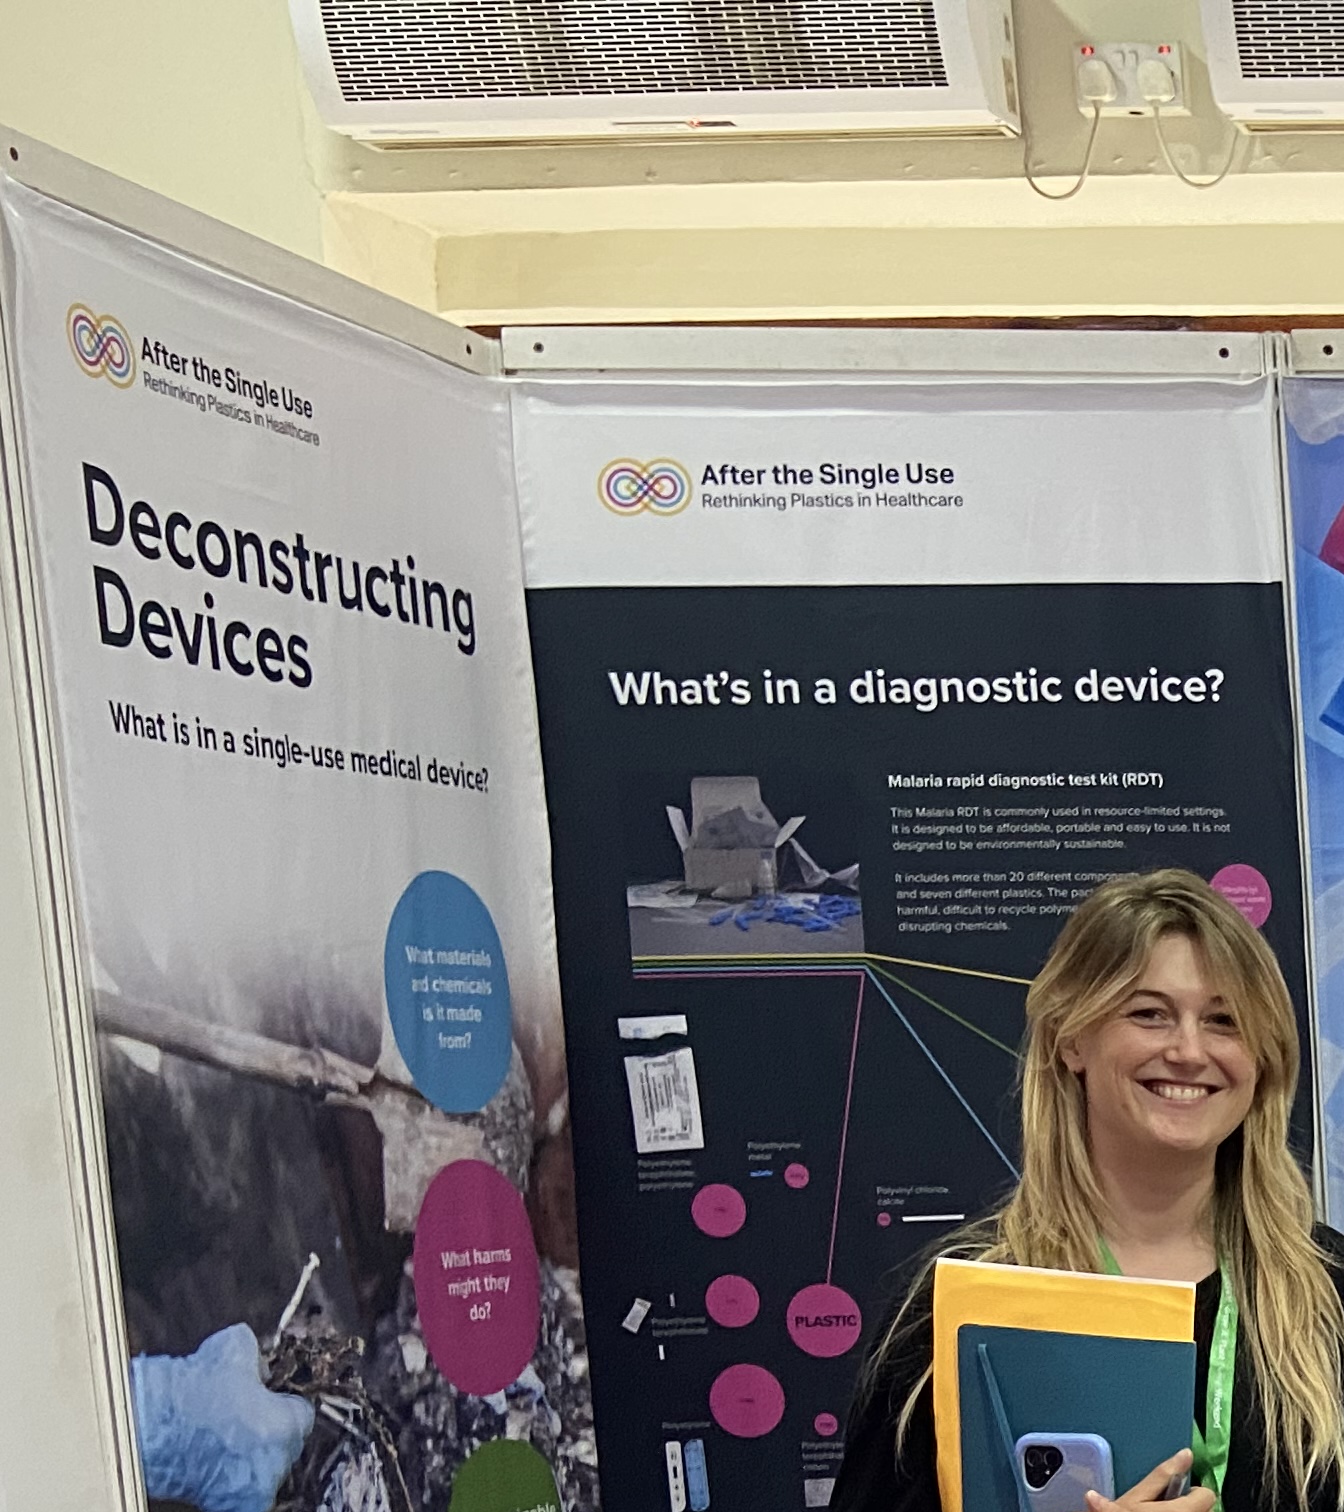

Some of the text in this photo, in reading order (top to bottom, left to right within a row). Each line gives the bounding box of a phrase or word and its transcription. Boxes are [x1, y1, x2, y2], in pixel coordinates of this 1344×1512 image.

[142, 337, 312, 418] After the Single Use
[143, 371, 320, 446] Rethinking Plastics in Healthcare
[701, 463, 954, 488] After the Single Use
[702, 492, 963, 510] Rethinking Plastics in Healthcare
[82, 462, 476, 655] Deconstructing
[93, 565, 313, 688] Devices
[608, 666, 1225, 711] What’s in a diagnostic device?
[109, 700, 488, 792] What is in a single-use medical device?
[888, 773, 1164, 790] Malaria rapid diagnostic test kit (RDT)
[890, 806, 1226, 819] This Malaria RDT is commonly used in resource-limited settings.
[892, 822, 1230, 836] It is designed to be affordable, portable and easy to use. It is not
[893, 839, 1127, 852] designed to be environmentally sustainable.
[895, 872, 1072, 883] It includes more than 20 different
[896, 888, 1069, 900] and seven different plastics. The
[898, 904, 940, 916] harmful,
[943, 904, 982, 915] difficult
[984, 904, 995, 914] to
[998, 904, 1036, 916] recycle
[899, 920, 1010, 934] disrupting chemicals.
[405, 945, 492, 968] What materials
[432, 976, 492, 994] chemicals
[423, 1004, 482, 1022] is it made
[438, 1032, 472, 1049] from?
[441, 1249, 512, 1270] What harms
[448, 1274, 510, 1298] might they
[470, 1302, 492, 1321] do?
[795, 1315, 856, 1328] PLASTIC
